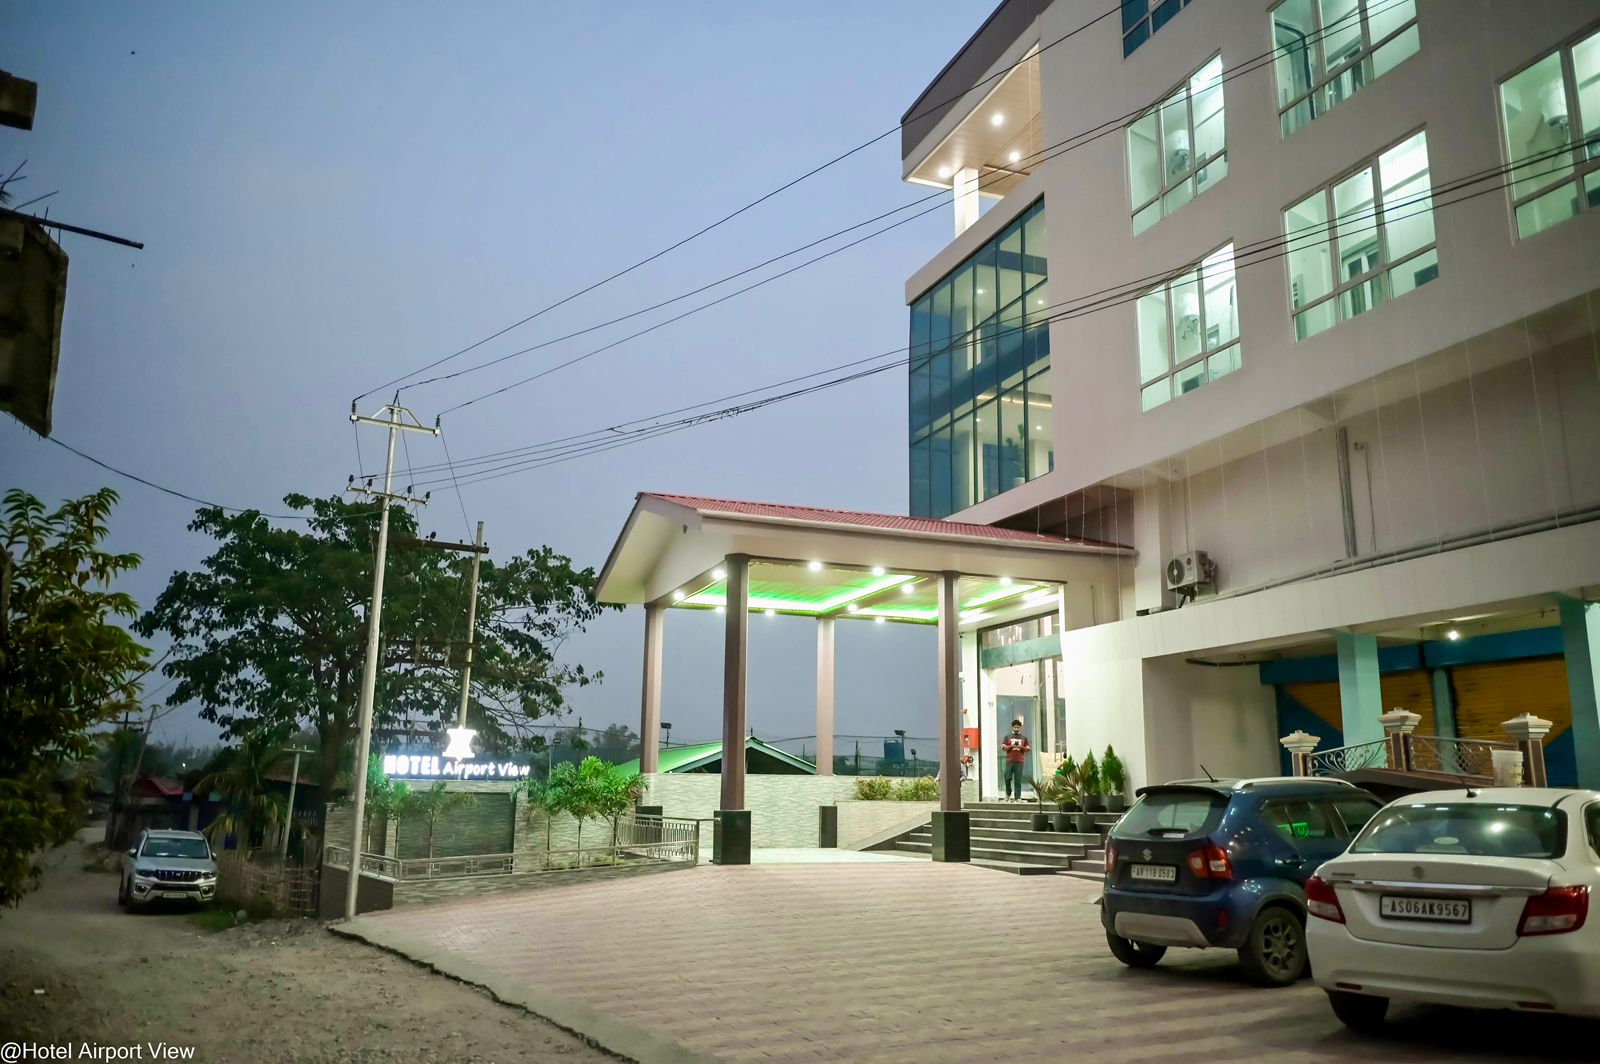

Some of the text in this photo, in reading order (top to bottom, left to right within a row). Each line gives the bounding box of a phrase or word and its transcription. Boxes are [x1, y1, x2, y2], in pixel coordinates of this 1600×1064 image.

[383, 754, 531, 780] HOTEL Airport View
[1390, 900, 1467, 917] AS06AK9567
